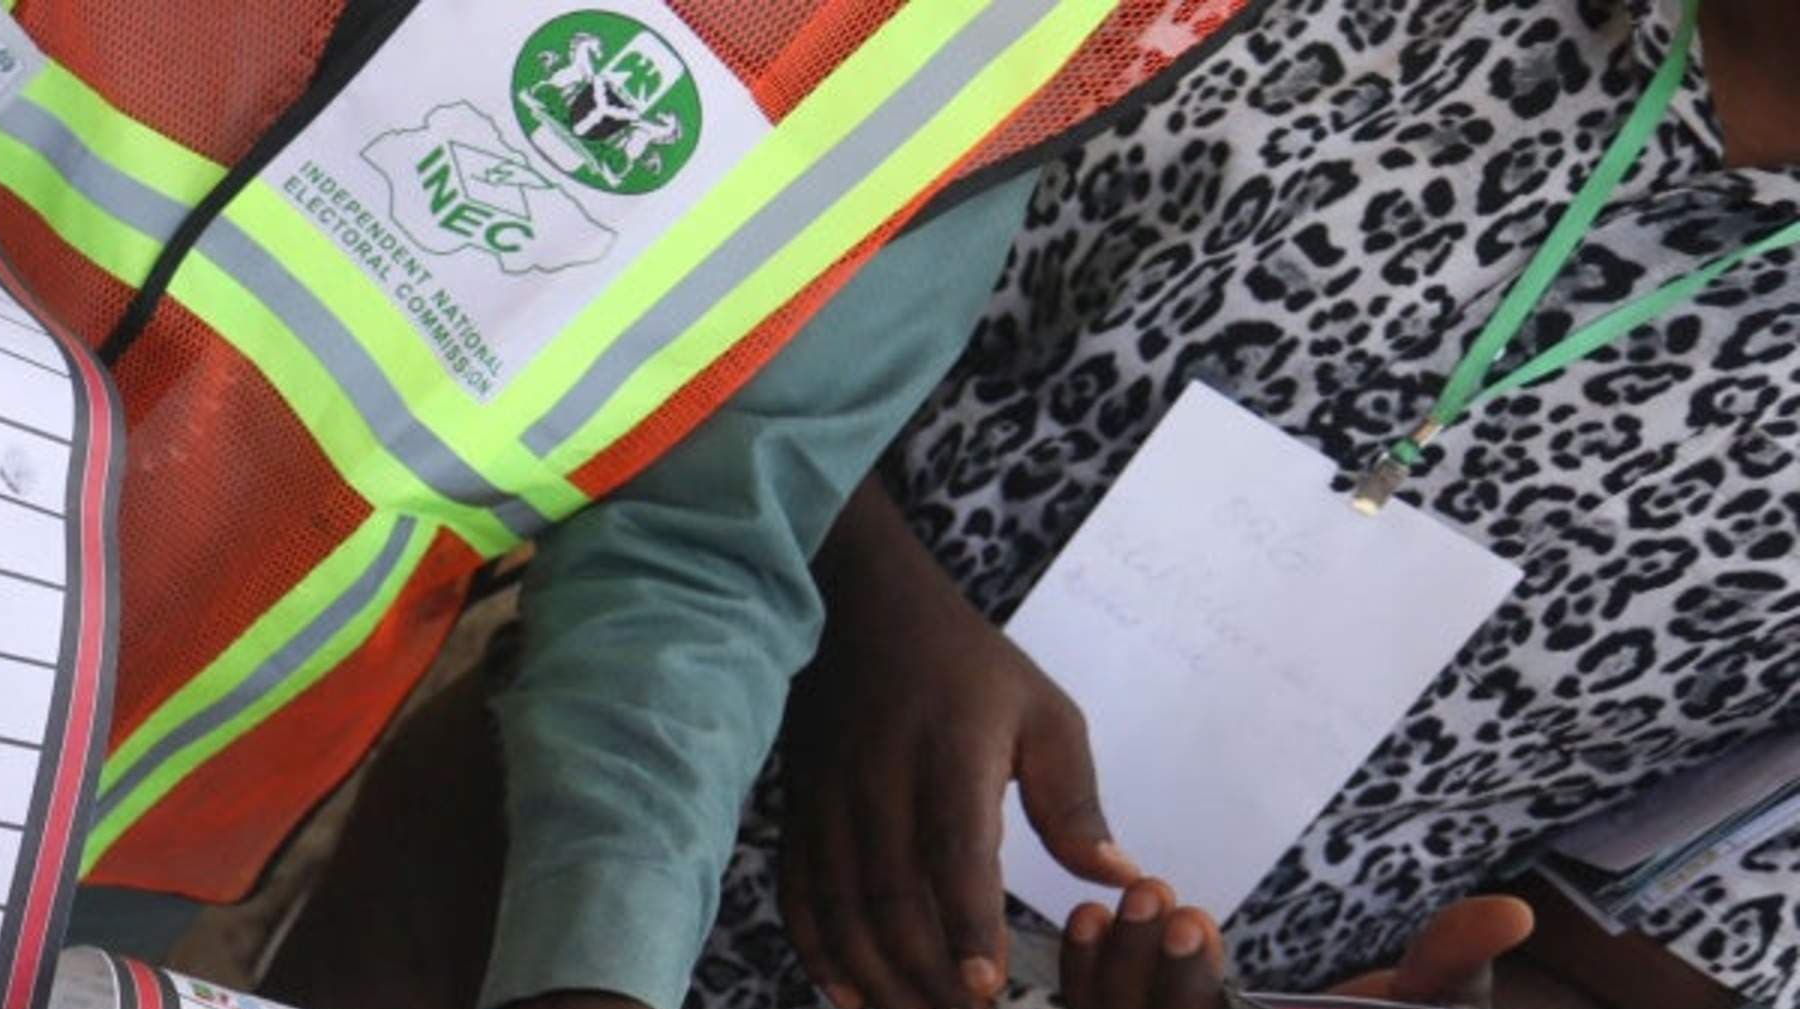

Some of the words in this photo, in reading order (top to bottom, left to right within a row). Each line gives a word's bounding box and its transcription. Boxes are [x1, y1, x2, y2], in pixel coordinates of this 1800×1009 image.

[283, 175, 392, 283] ELECTORAL
[395, 283, 494, 396] COMMISSION
[299, 160, 433, 285] INDEPENDENT
[431, 288, 503, 378] NATIONAL
[416, 145, 535, 253] INEC
